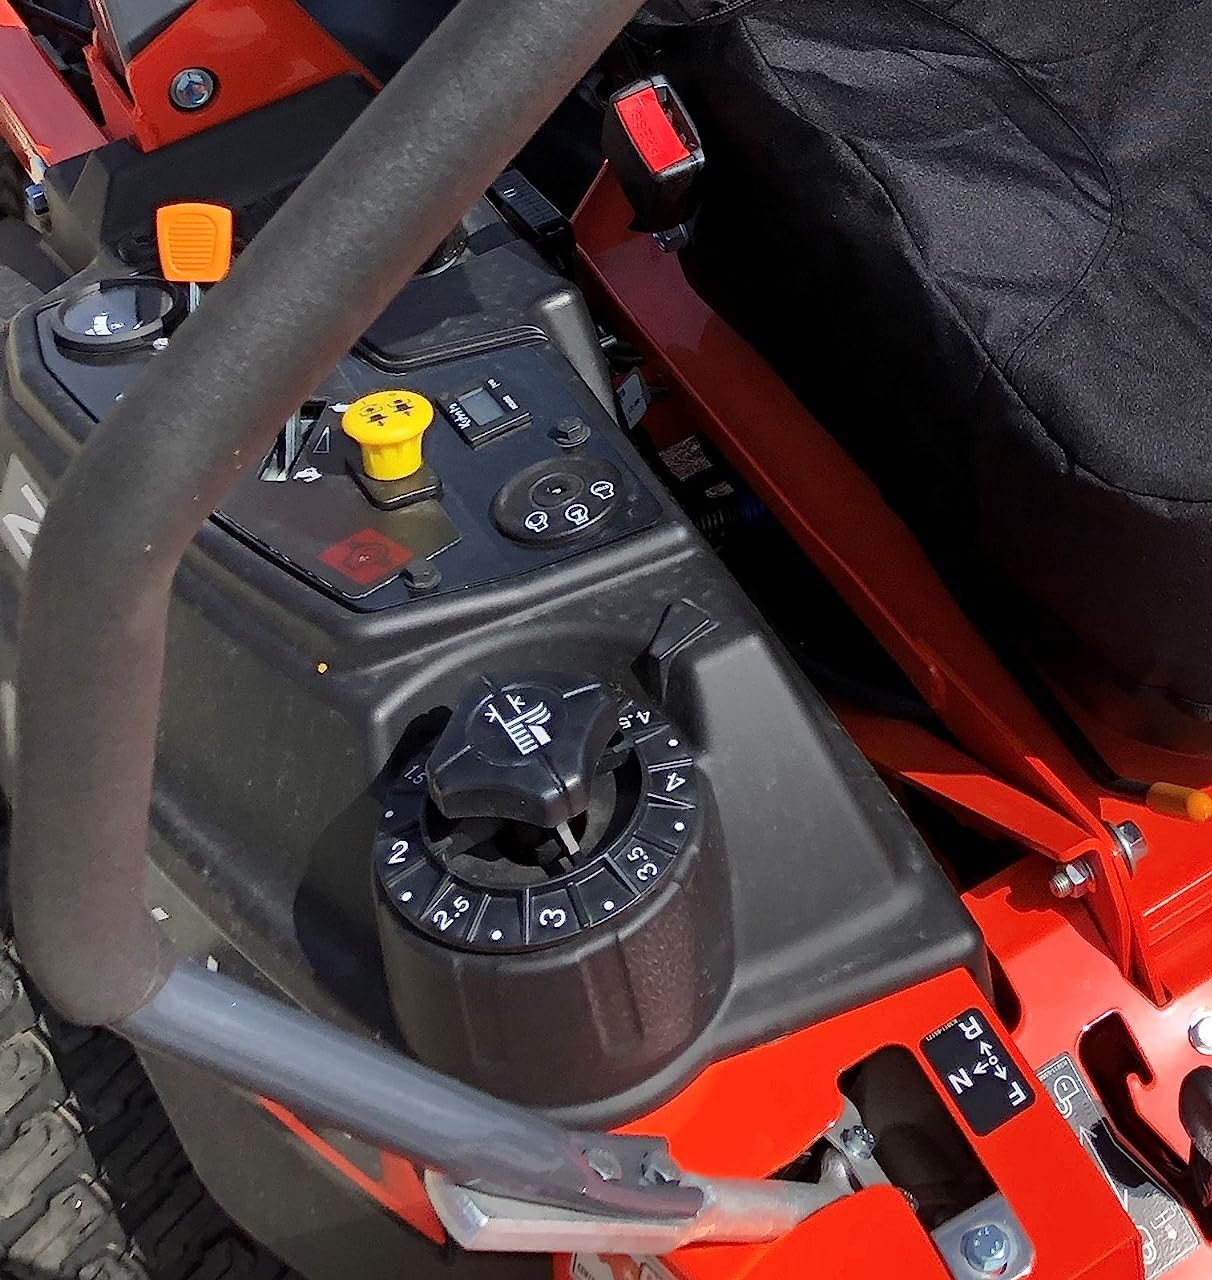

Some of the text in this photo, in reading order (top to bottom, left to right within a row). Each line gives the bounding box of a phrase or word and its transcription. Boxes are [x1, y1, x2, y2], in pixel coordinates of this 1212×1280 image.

[618, 709, 652, 731] 4.5
[404, 764, 427, 785] 1.5
[666, 772, 687, 793] 4
[388, 841, 410, 865] 2
[626, 846, 658, 882] 3.5
[432, 895, 470, 931] 2.5
[539, 908, 566, 929] 3
[959, 1016, 983, 1041] R
[948, 1068, 973, 1094] N
[1007, 1081, 1027, 1107] F
